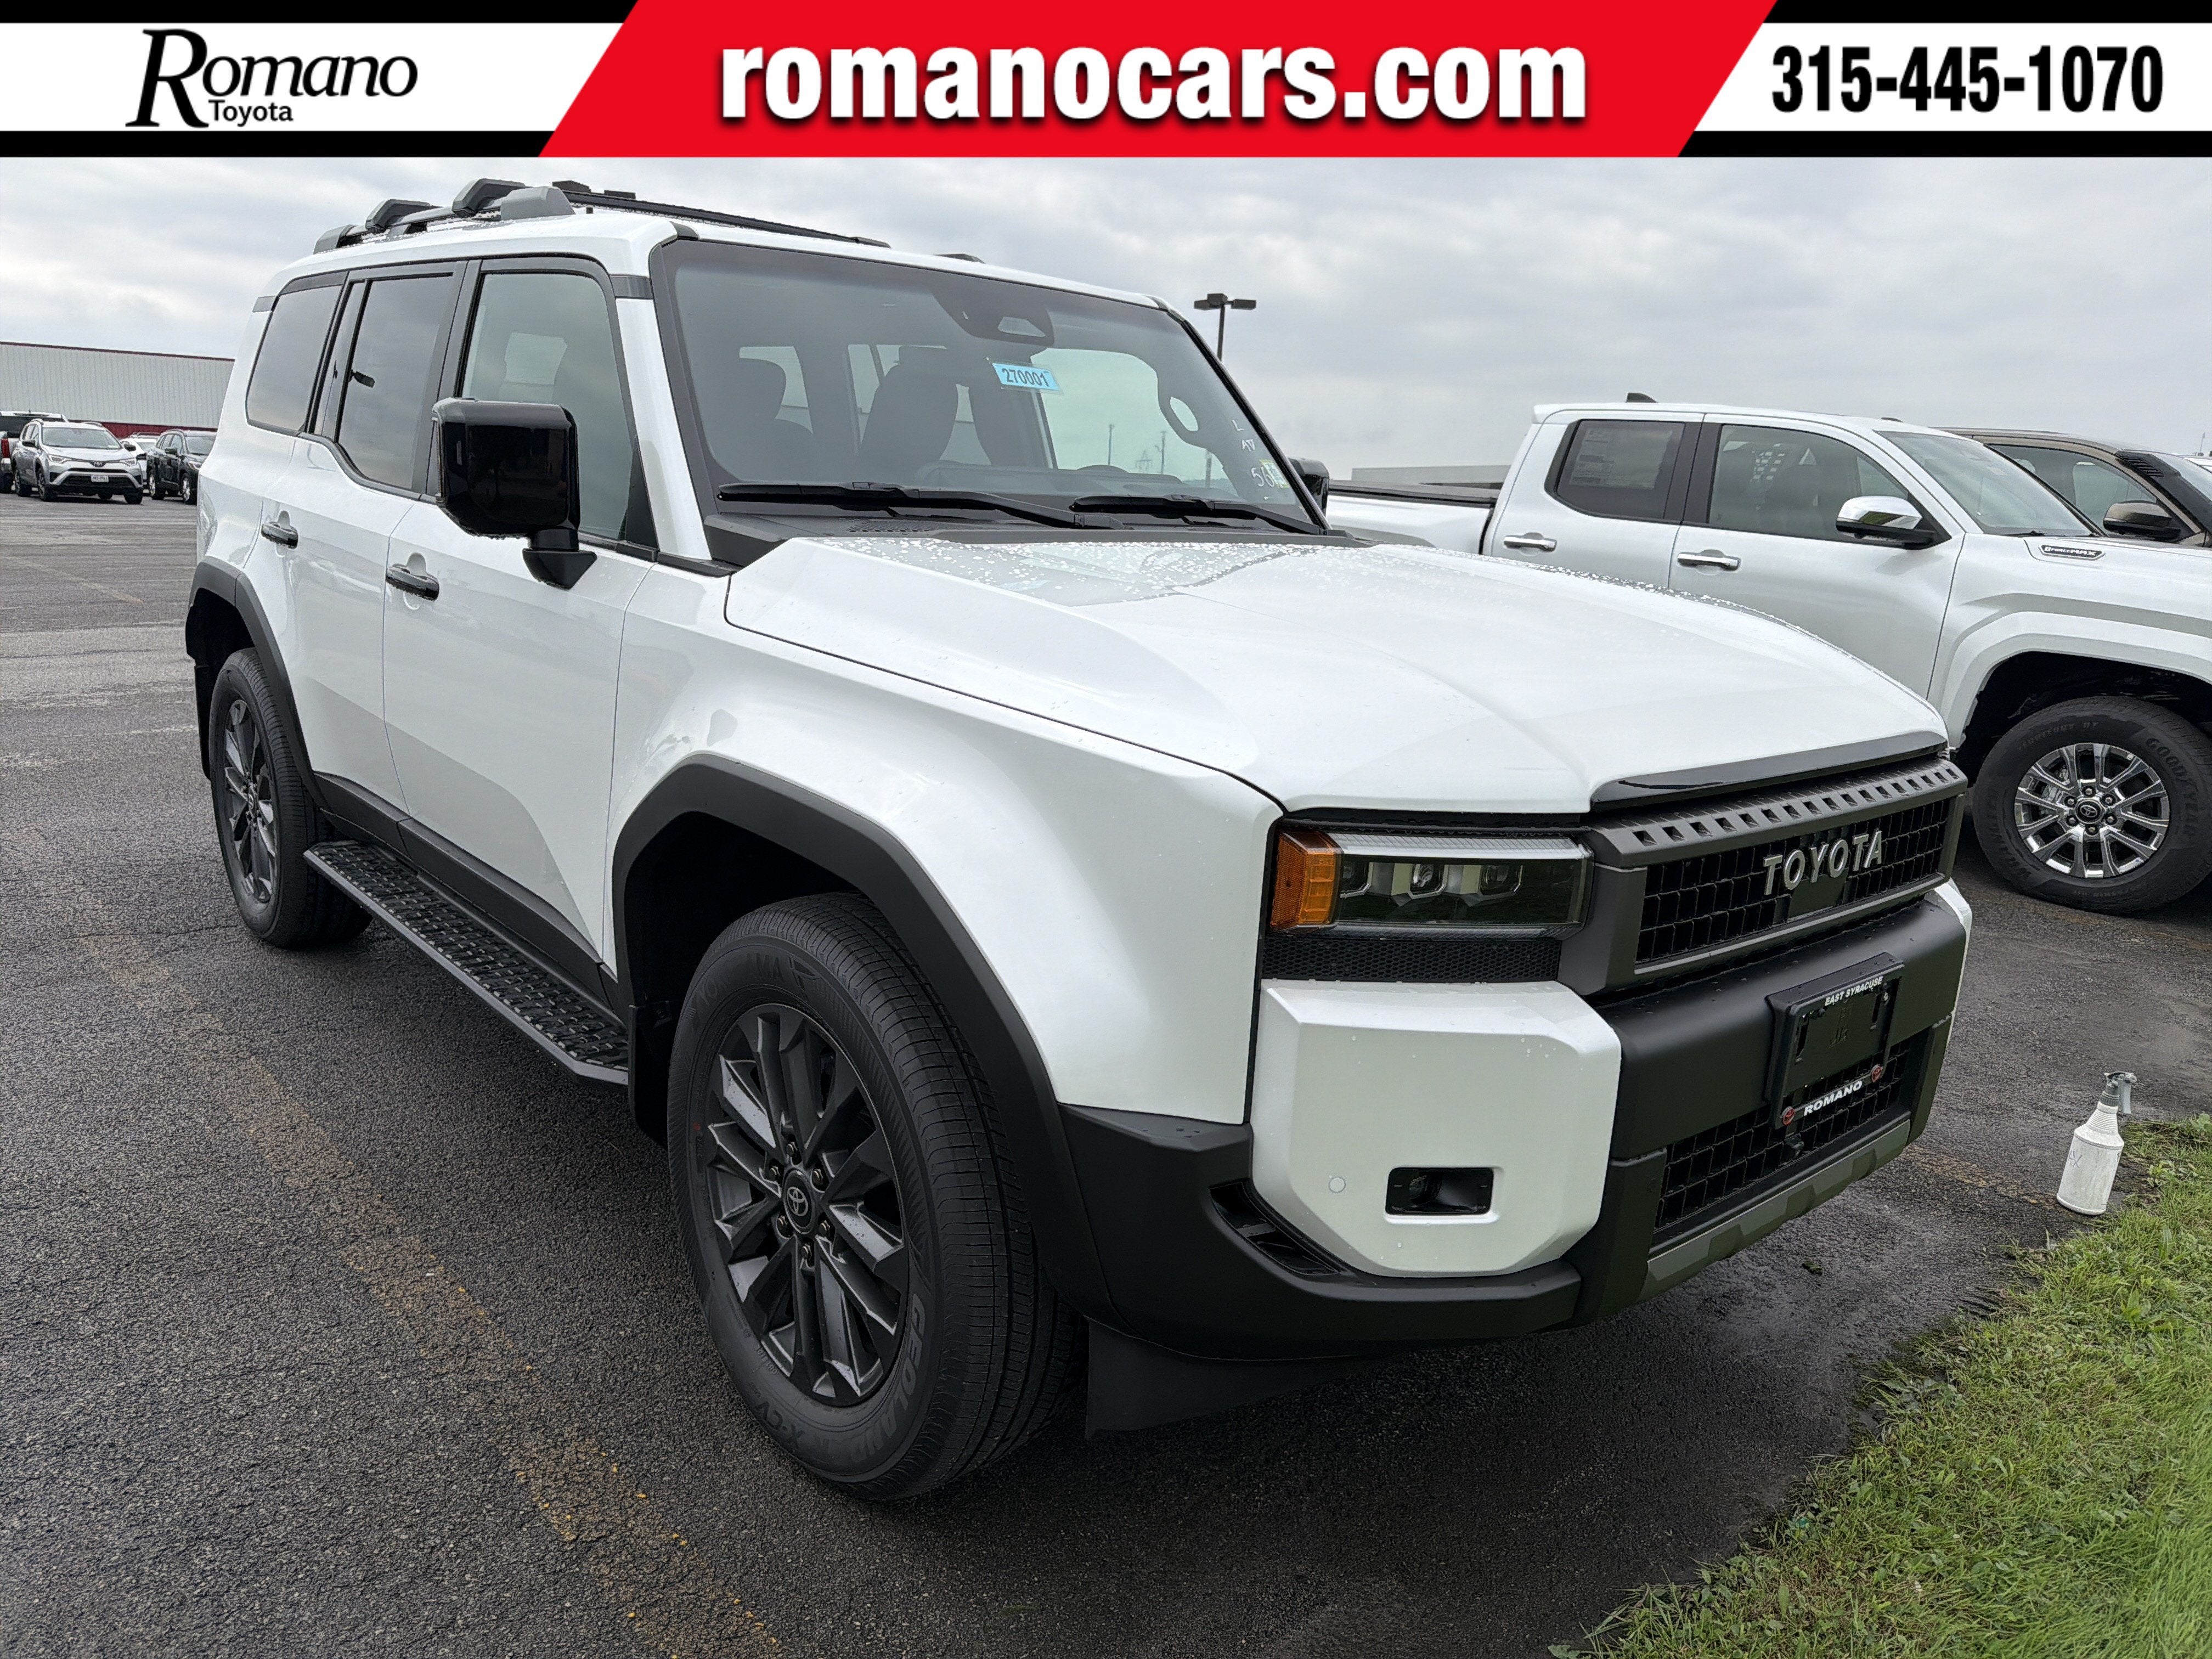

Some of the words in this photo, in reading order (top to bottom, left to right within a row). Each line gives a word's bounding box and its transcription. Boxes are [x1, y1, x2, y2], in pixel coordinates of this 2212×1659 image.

[1002, 368, 1049, 387] 270001
[1763, 830, 1882, 896] TOYOTA
[1824, 991, 1845, 1006] EAST
[1845, 975, 1883, 998] SYRACUSE
[1803, 1080, 1863, 1117] ROMANO
